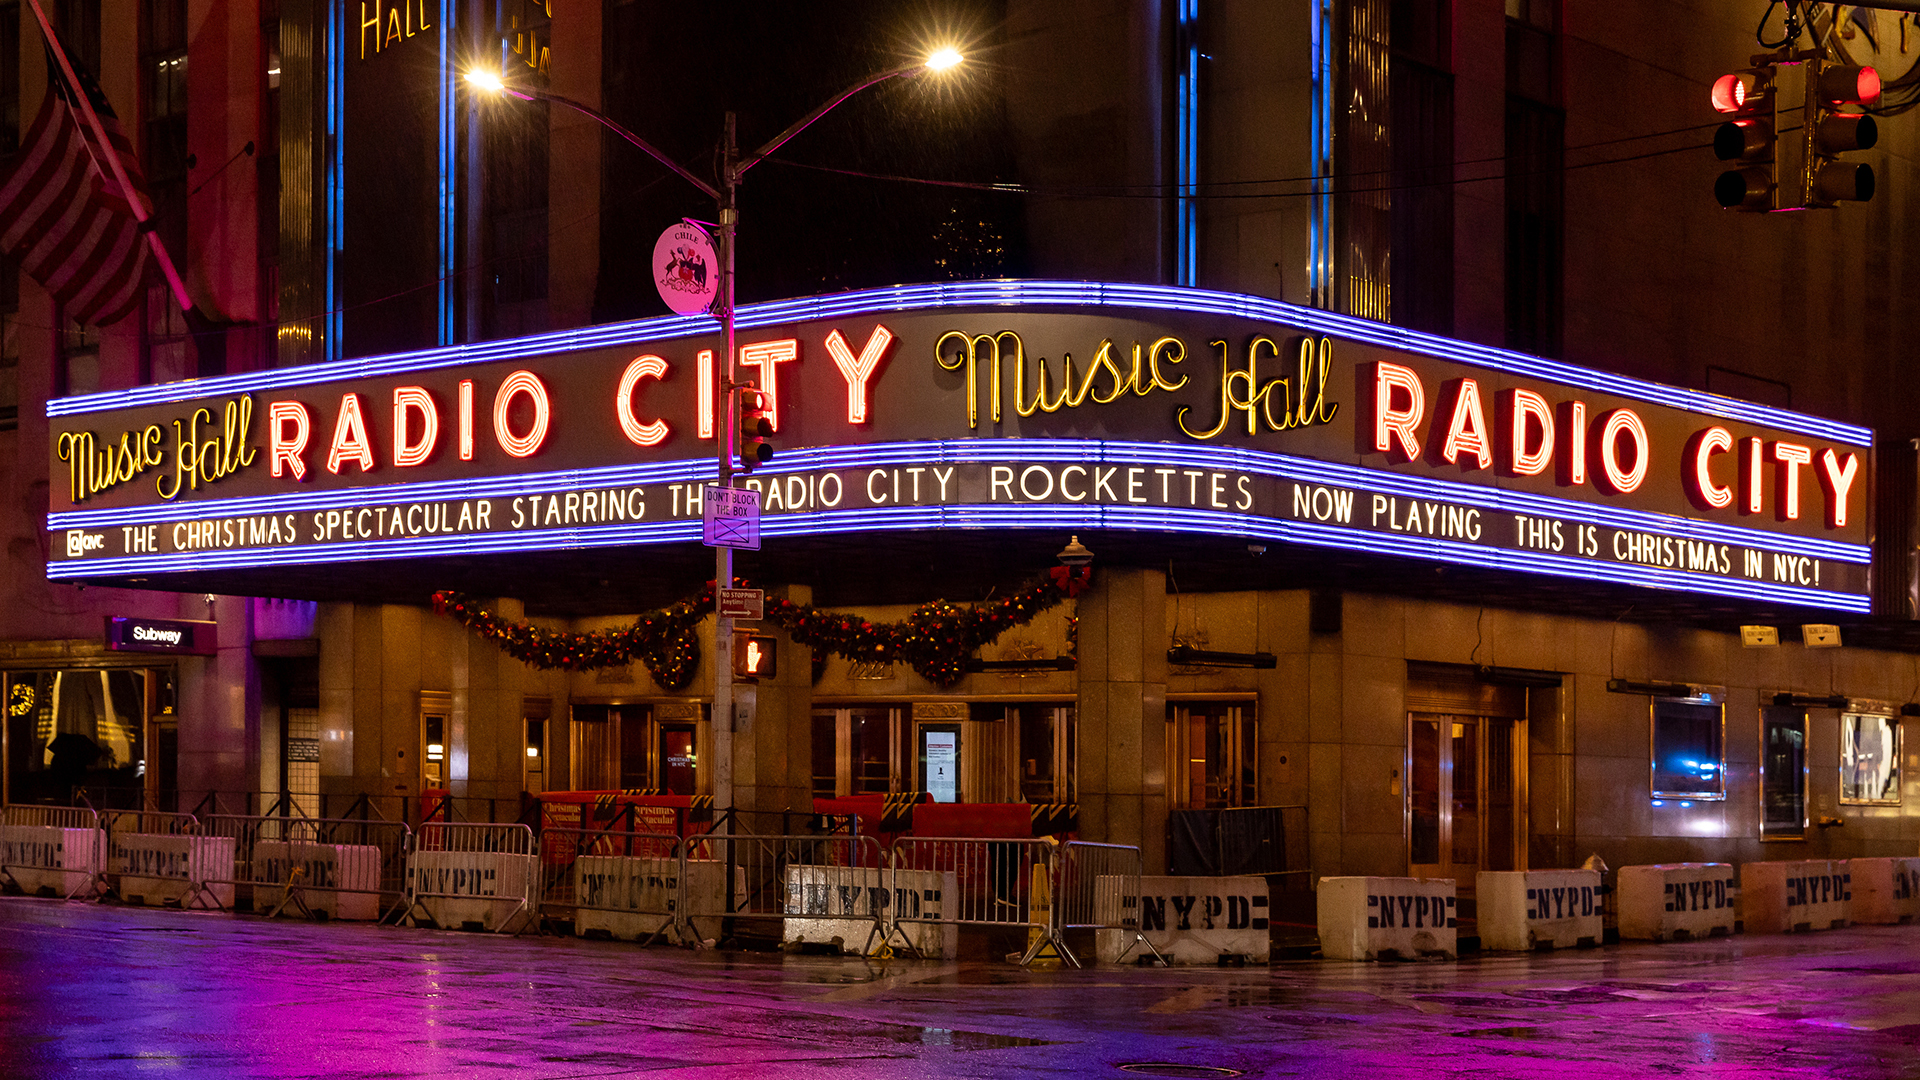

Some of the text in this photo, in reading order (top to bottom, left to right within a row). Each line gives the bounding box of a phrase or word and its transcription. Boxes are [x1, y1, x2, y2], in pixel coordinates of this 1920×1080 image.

[361, 0, 431, 60] HALL
[674, 231, 699, 245] CHILE
[934, 328, 1339, 440] Music Hall
[269, 323, 894, 482] RADIO CITY
[58, 393, 257, 504] Music Hall
[1374, 360, 1859, 528] RADIO CITY
[707, 490, 757, 506] DON'T BLOCK
[716, 504, 748, 517] THE BOX
[122, 525, 158, 553] THE
[172, 514, 296, 551] CHRISTMAS
[313, 500, 492, 541] SPECTACULAR
[511, 487, 645, 529] STARRING
[866, 467, 955, 504] CITY
[990, 464, 1254, 511] ROCKETTES
[1293, 483, 1355, 524] NOW
[1371, 494, 1482, 541] PLAYING
[1515, 514, 1565, 553] THIS
[1578, 524, 1598, 558] IS
[1613, 530, 1731, 576] CHRISTMAS
[1744, 548, 1763, 580] IN
[1773, 553, 1821, 587] NYC!
[133, 625, 182, 645] Subway
[419, 867, 482, 898] NYPD
[1672, 878, 1726, 912] NYPD
[1795, 874, 1843, 905] NYPD
[1142, 895, 1249, 931] NYPD
[1379, 894, 1446, 929] NYPD
[1536, 885, 1594, 920] NYPD
